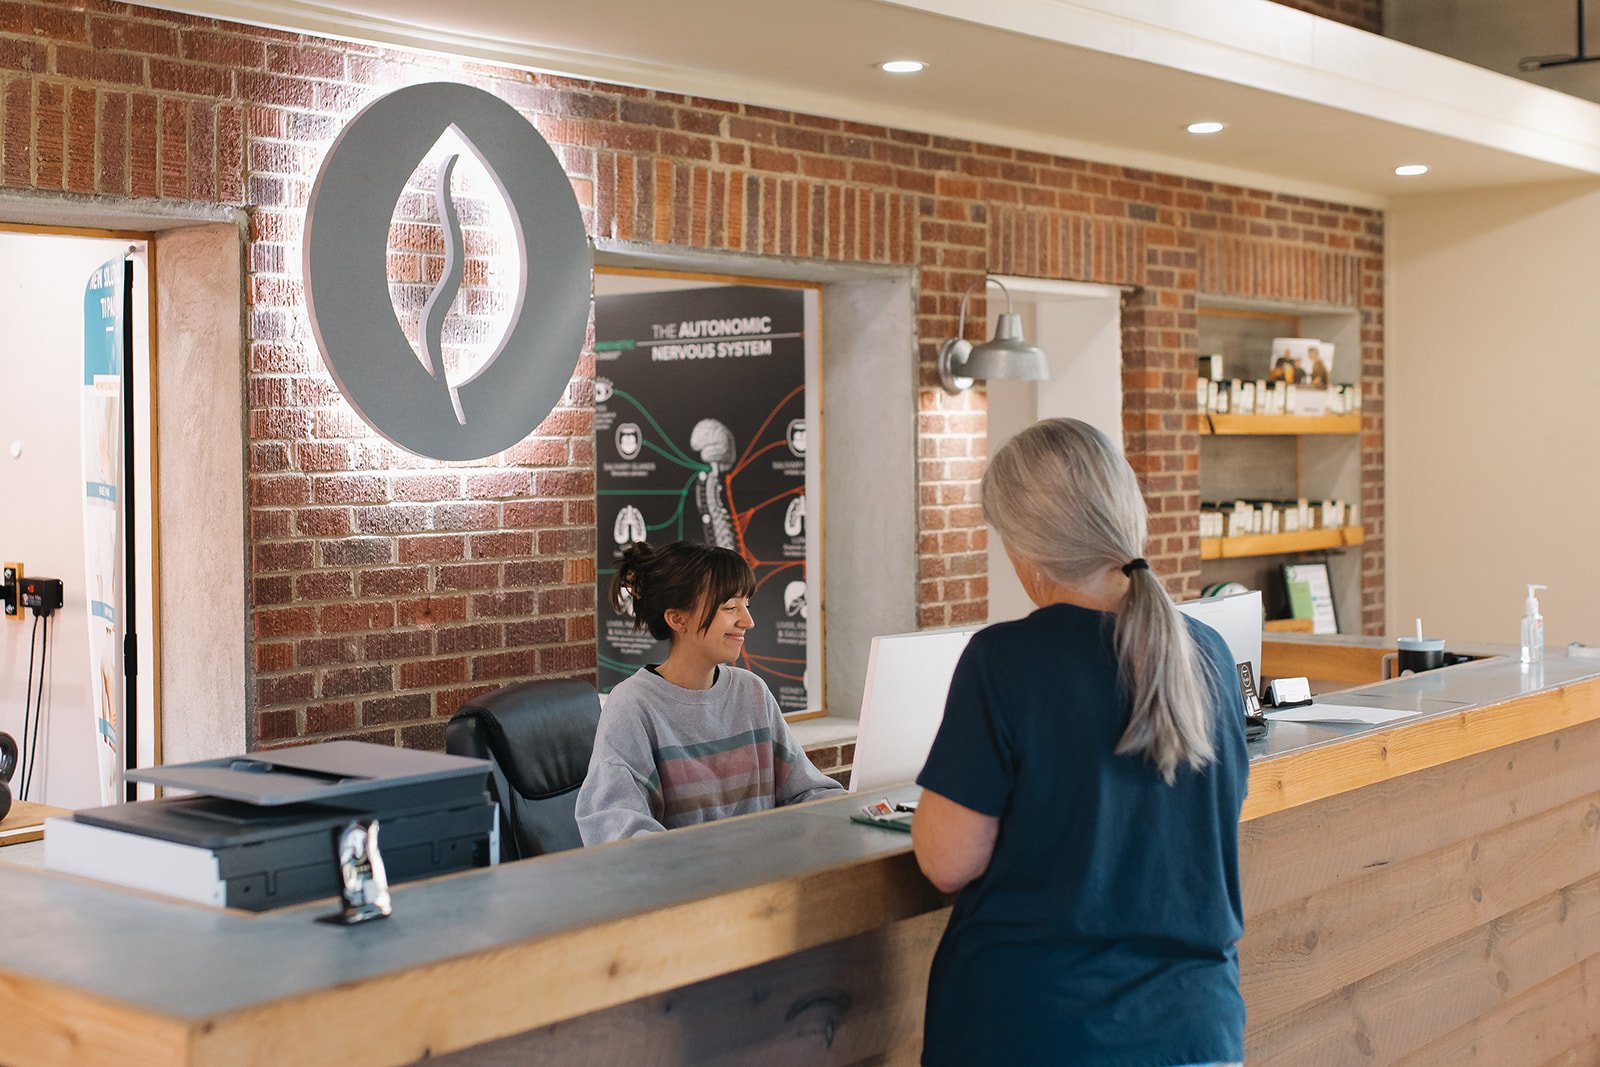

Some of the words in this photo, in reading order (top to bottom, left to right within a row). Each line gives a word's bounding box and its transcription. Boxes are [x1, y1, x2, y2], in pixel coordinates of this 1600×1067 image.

[652, 323, 677, 340] THE
[678, 316, 772, 338] AUTONOMIC
[652, 343, 716, 362] NERVOUS
[717, 340, 772, 358] SYSTEM
